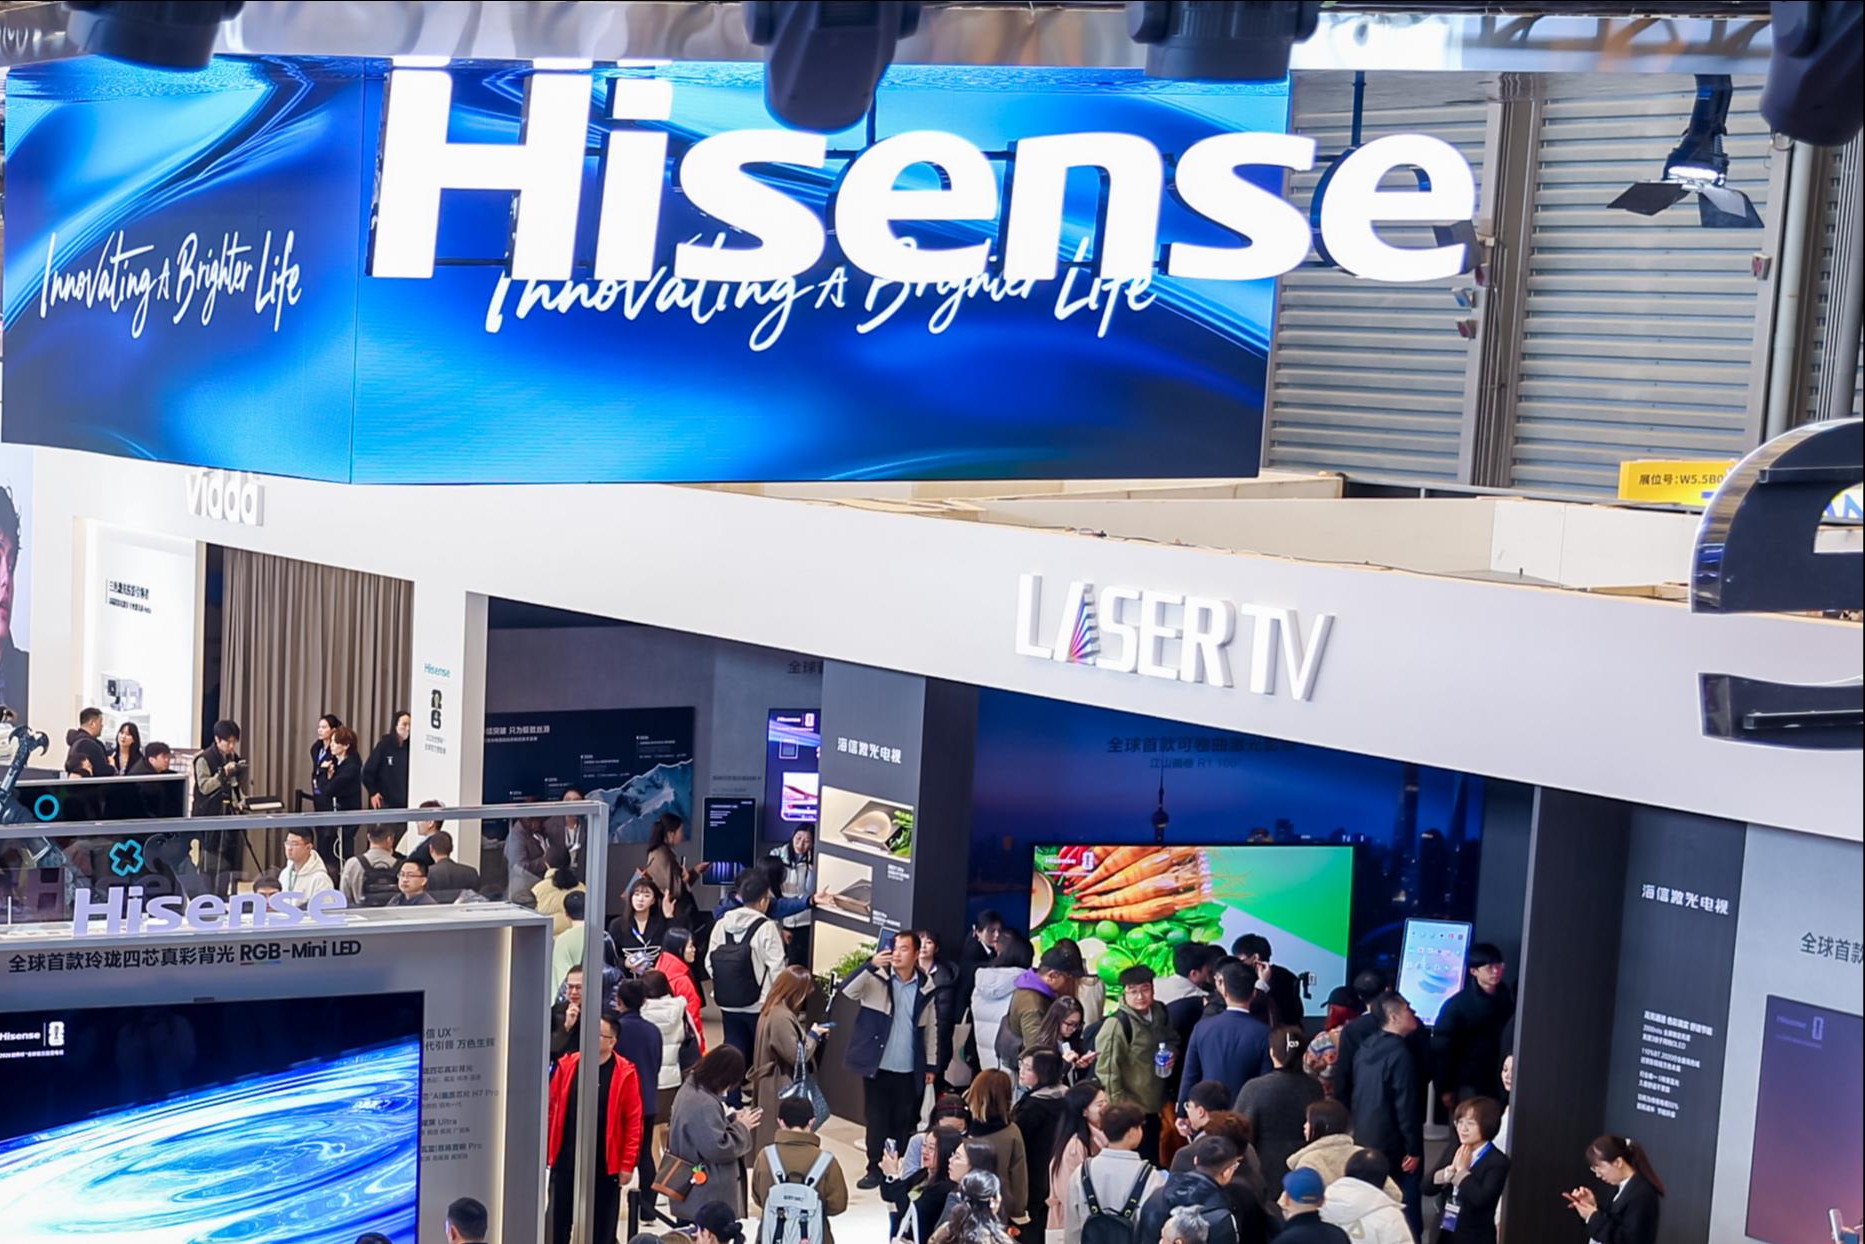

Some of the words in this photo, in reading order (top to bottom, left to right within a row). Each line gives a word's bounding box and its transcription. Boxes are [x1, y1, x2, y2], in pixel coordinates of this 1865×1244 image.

[371, 66, 1476, 285] Hisense
[40, 230, 158, 338] Innovating
[157, 258, 171, 300] A
[173, 232, 253, 325] Brighter
[255, 230, 302, 331] Life
[1015, 573, 1235, 689] LASER
[1241, 601, 1336, 701] TV
[837, 737, 902, 765] 海信激光电视
[72, 886, 348, 937] Hisense
[1641, 884, 1729, 915] 海信激光电视
[8, 945, 235, 974] 全球首款玲珑四芯真彩背光
[240, 940, 327, 962] RGB-Mini
[332, 941, 362, 956] LED
[0, 1030, 41, 1041] Hisense
[424, 1041, 454, 1052] 代引领
